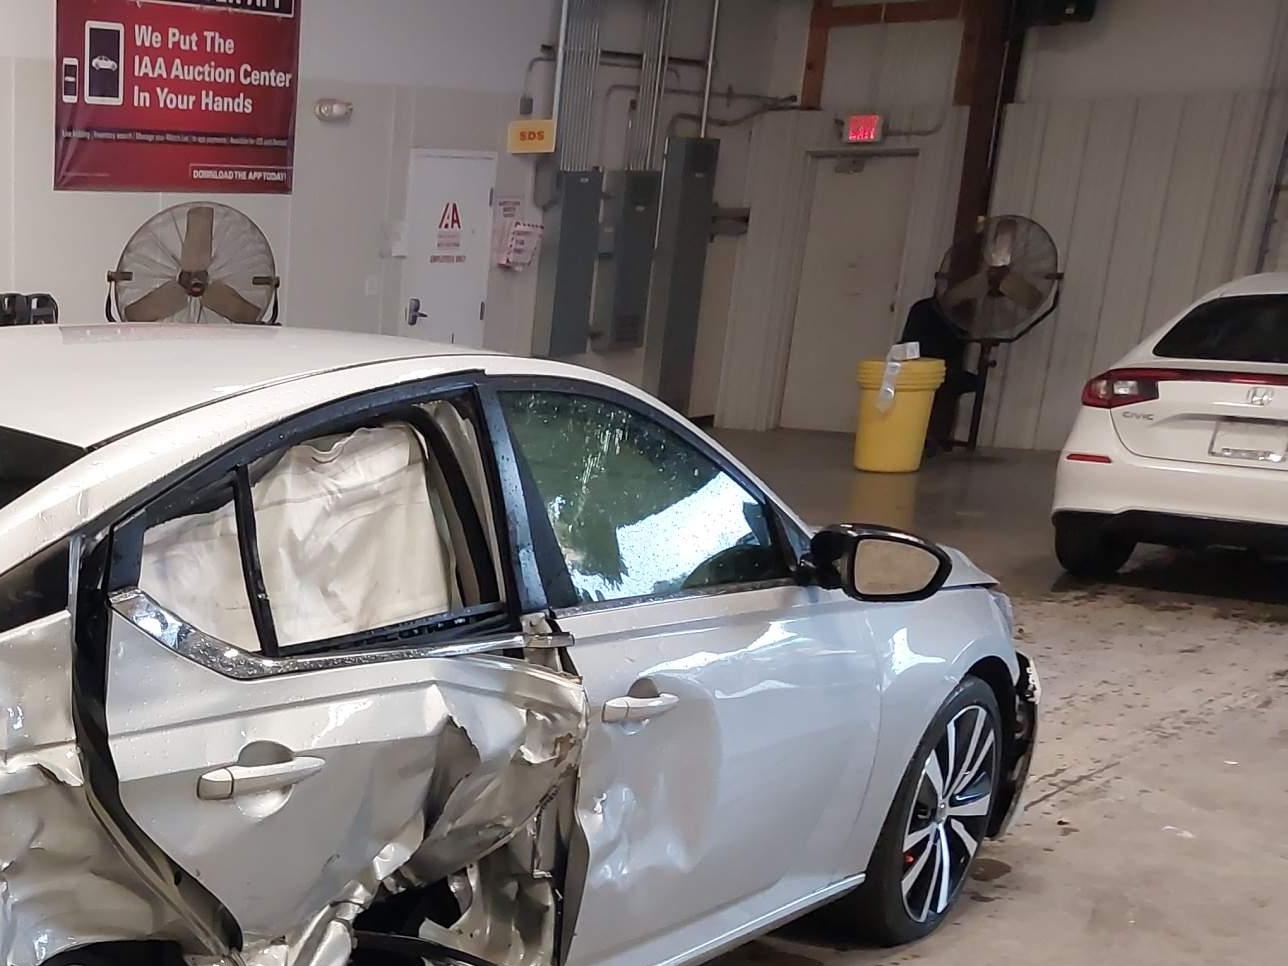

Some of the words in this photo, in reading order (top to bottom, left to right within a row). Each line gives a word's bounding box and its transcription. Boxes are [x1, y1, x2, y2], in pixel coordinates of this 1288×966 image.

[134, 24, 161, 48] We
[168, 27, 198, 51] Put
[204, 31, 235, 54] The
[134, 55, 167, 79] IAA
[170, 58, 235, 83] Auction
[240, 63, 292, 88] Center
[133, 86, 150, 107] In
[156, 87, 196, 110] Your
[201, 90, 253, 113] Hands
[519, 130, 545, 142] SDS
[248, 171, 263, 180] APP
[1122, 411, 1154, 421] CIVIC
